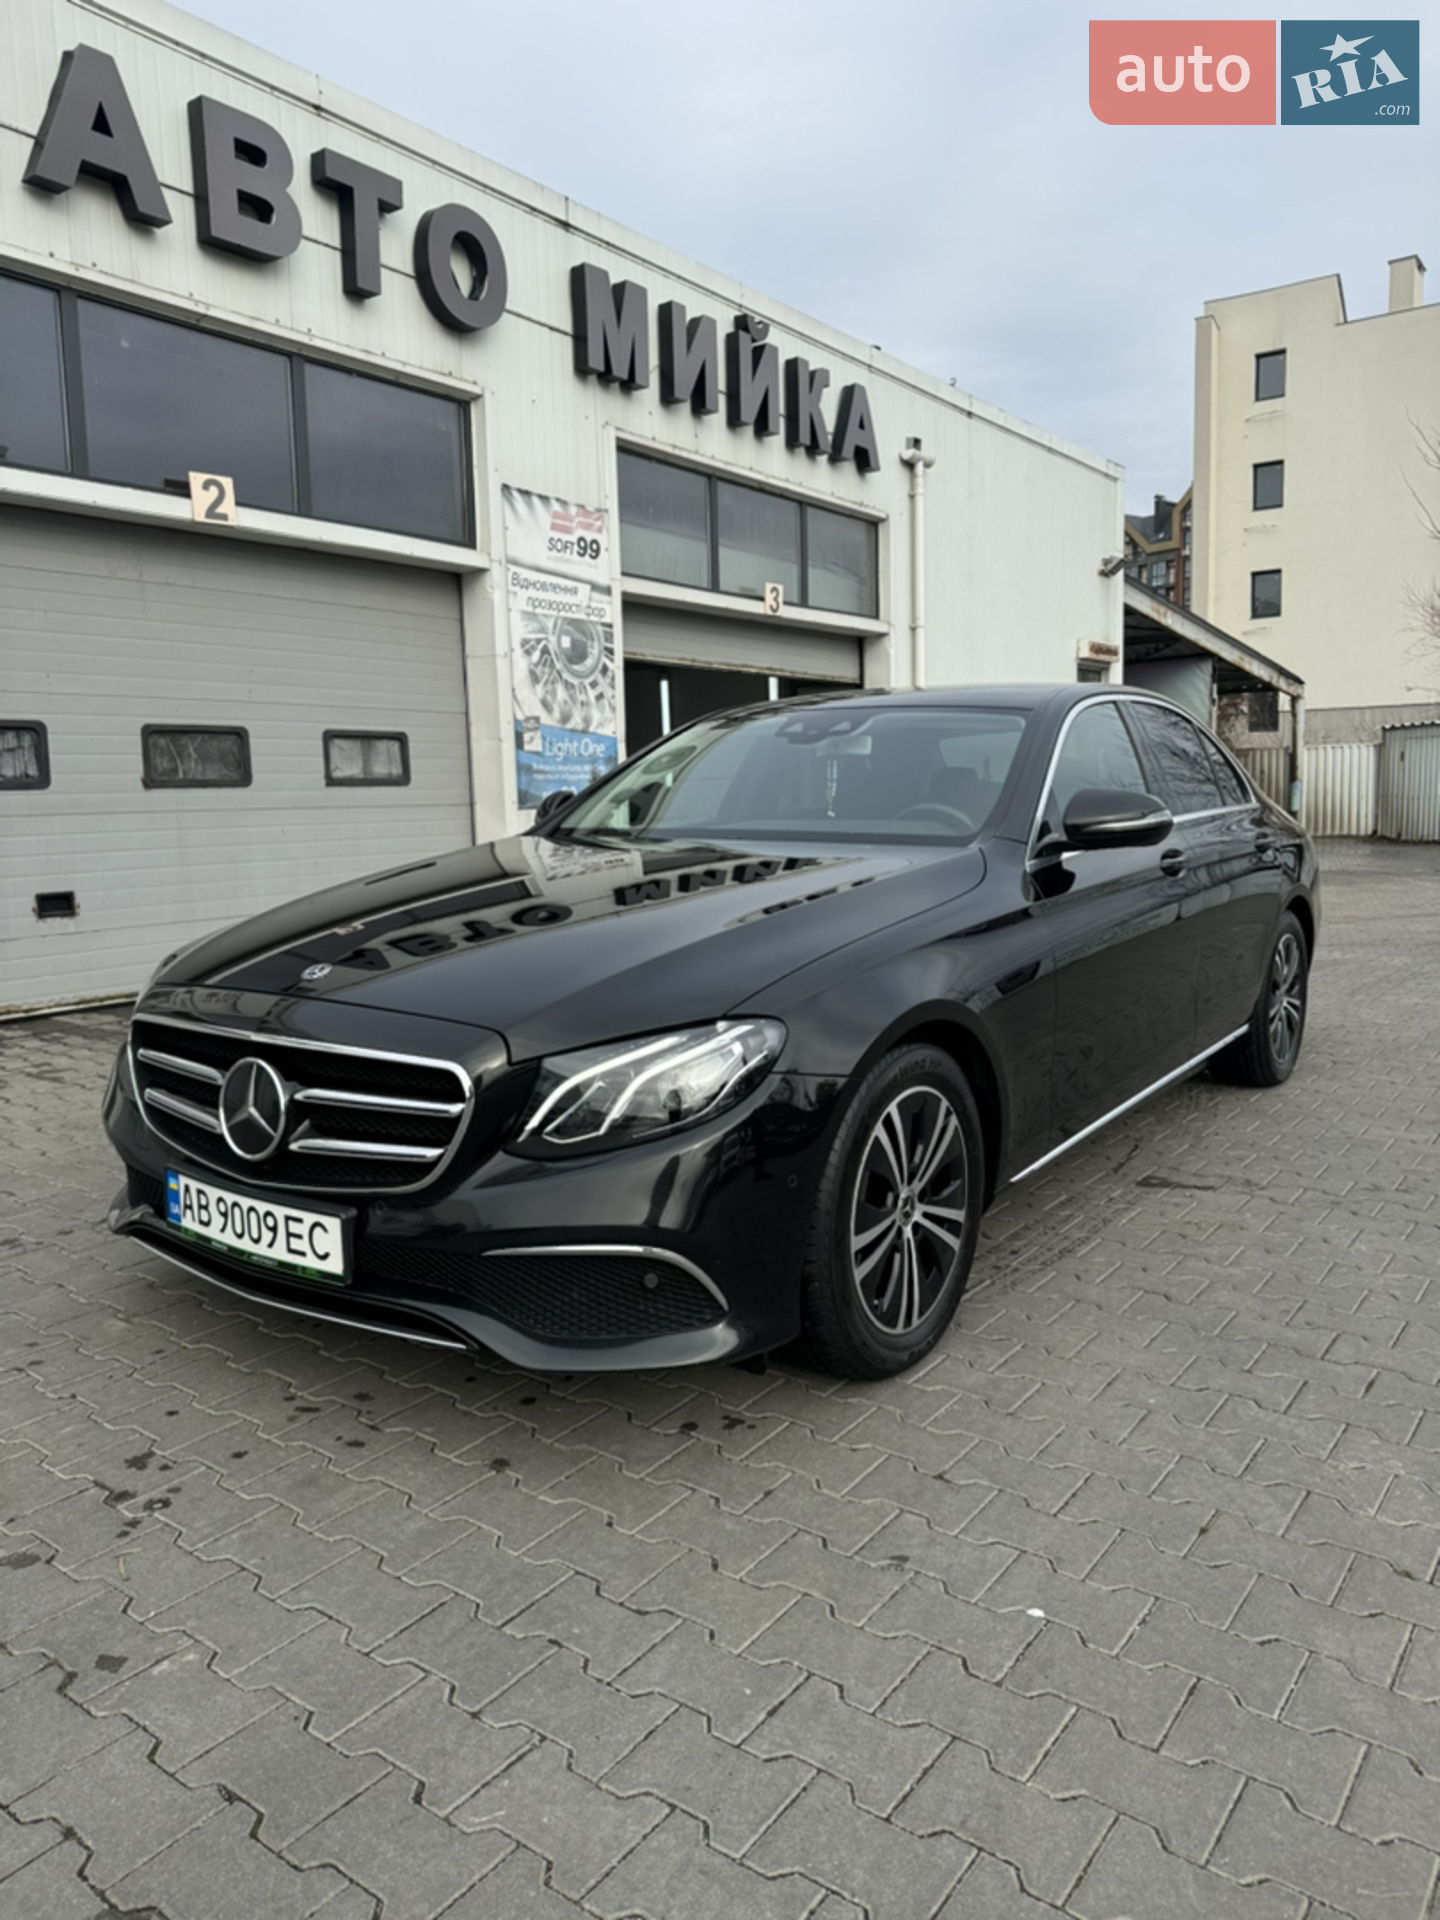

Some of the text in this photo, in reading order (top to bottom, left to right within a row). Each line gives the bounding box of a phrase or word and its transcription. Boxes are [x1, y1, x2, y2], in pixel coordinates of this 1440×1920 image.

[21, 43, 881, 473] АВТО МИЙКА
[202, 477, 229, 522] 2
[511, 571, 579, 596] Відновлення
[526, 596, 607, 618] прозорості фар
[769, 586, 780, 614] 3
[545, 737, 605, 761] Light One
